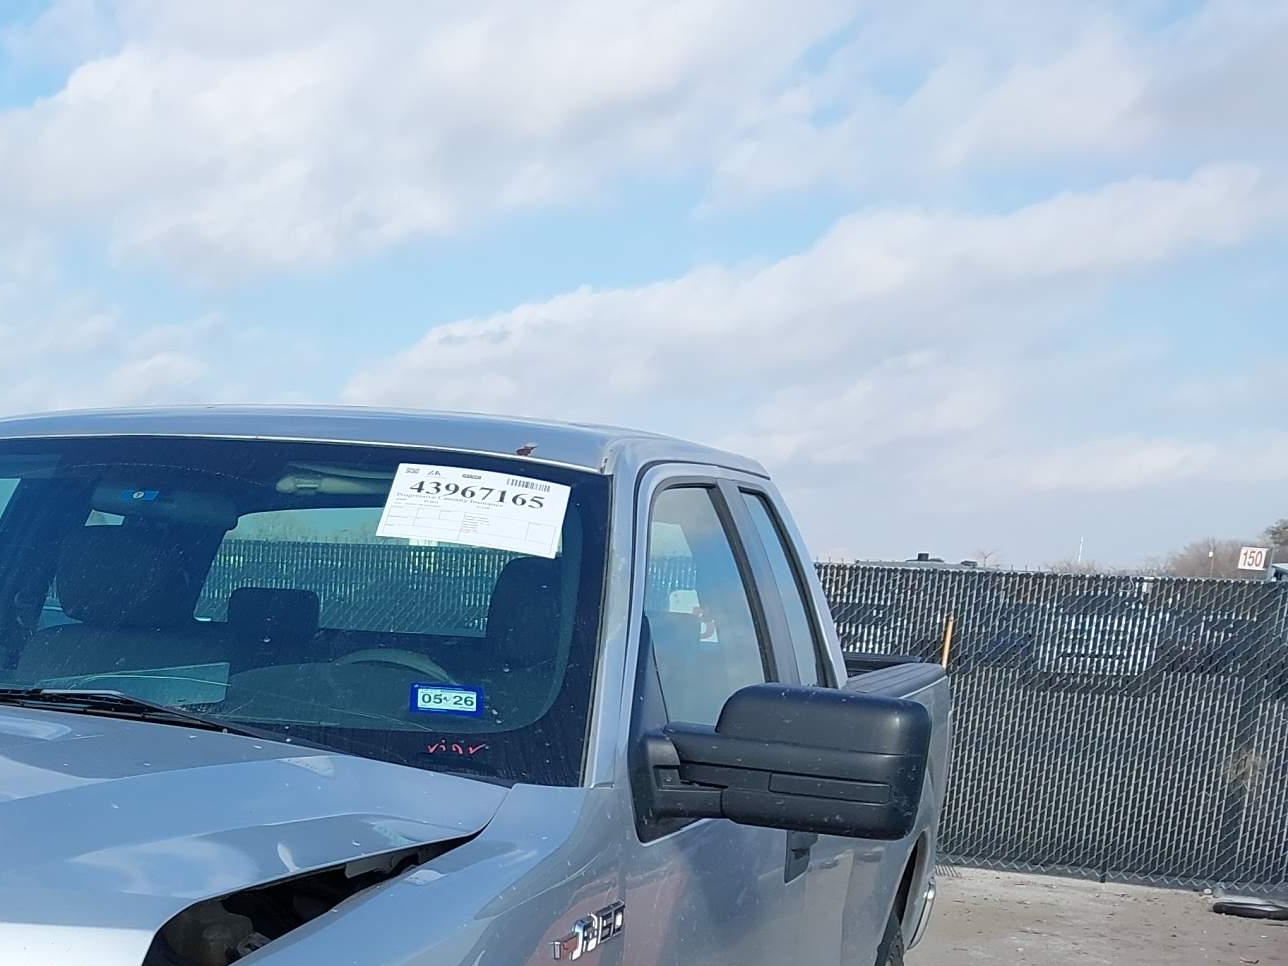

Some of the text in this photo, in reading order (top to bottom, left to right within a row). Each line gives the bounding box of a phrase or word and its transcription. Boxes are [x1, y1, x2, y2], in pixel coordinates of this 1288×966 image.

[409, 480, 545, 510] 43967165
[1242, 550, 1263, 568] 150
[421, 693, 474, 707] 05 26
